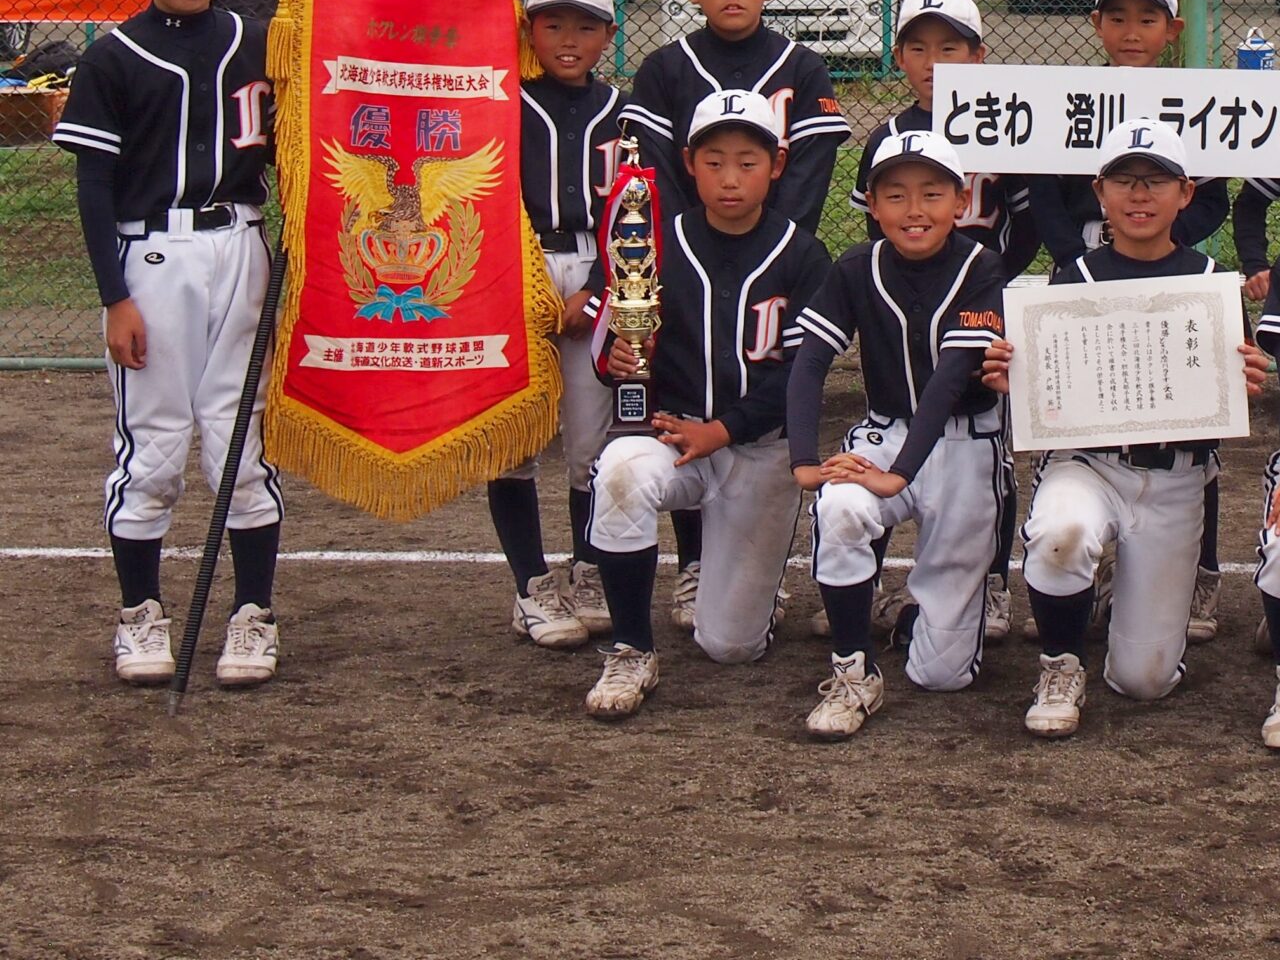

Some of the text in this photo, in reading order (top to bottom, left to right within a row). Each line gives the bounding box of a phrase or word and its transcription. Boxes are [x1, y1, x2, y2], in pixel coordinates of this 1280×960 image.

[350, 104, 462, 151] 優勝
[720, 94, 746, 115] L
[944, 90, 1033, 147] ときわ
[900, 134, 925, 154] L
[1127, 127, 1154, 149] L
[746, 296, 788, 362] L
[1185, 319, 1201, 368] 表彰状
